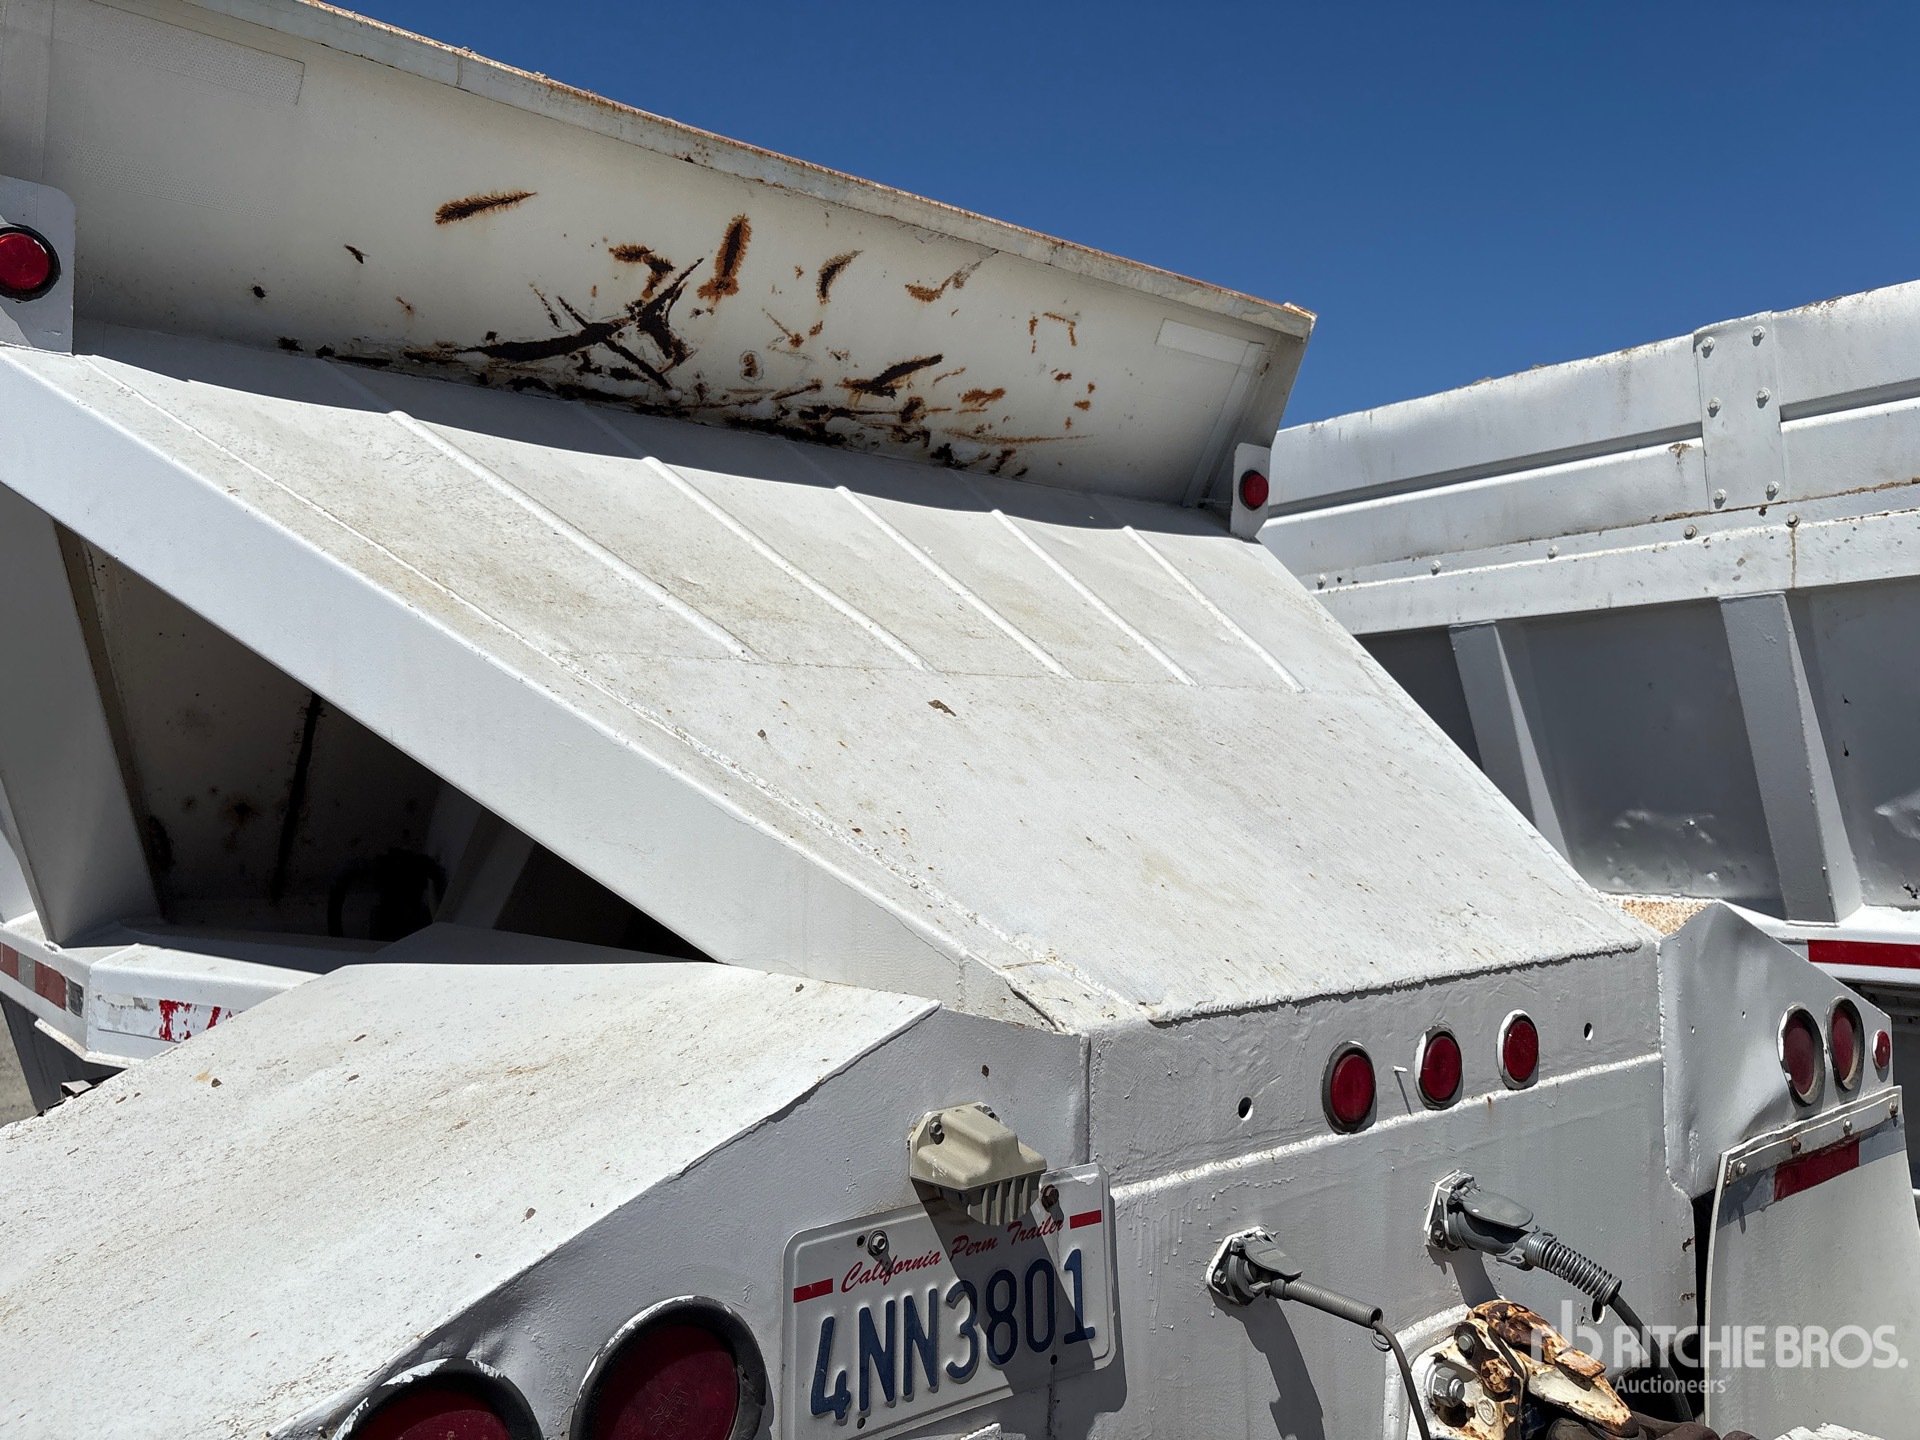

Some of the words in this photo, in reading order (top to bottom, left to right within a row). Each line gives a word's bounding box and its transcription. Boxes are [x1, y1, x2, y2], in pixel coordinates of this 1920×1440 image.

[841, 1250, 942, 1293] California
[950, 1235, 998, 1262] Perm
[1007, 1216, 1064, 1246] Trailer
[811, 1248, 1096, 1420] 4NN3801
